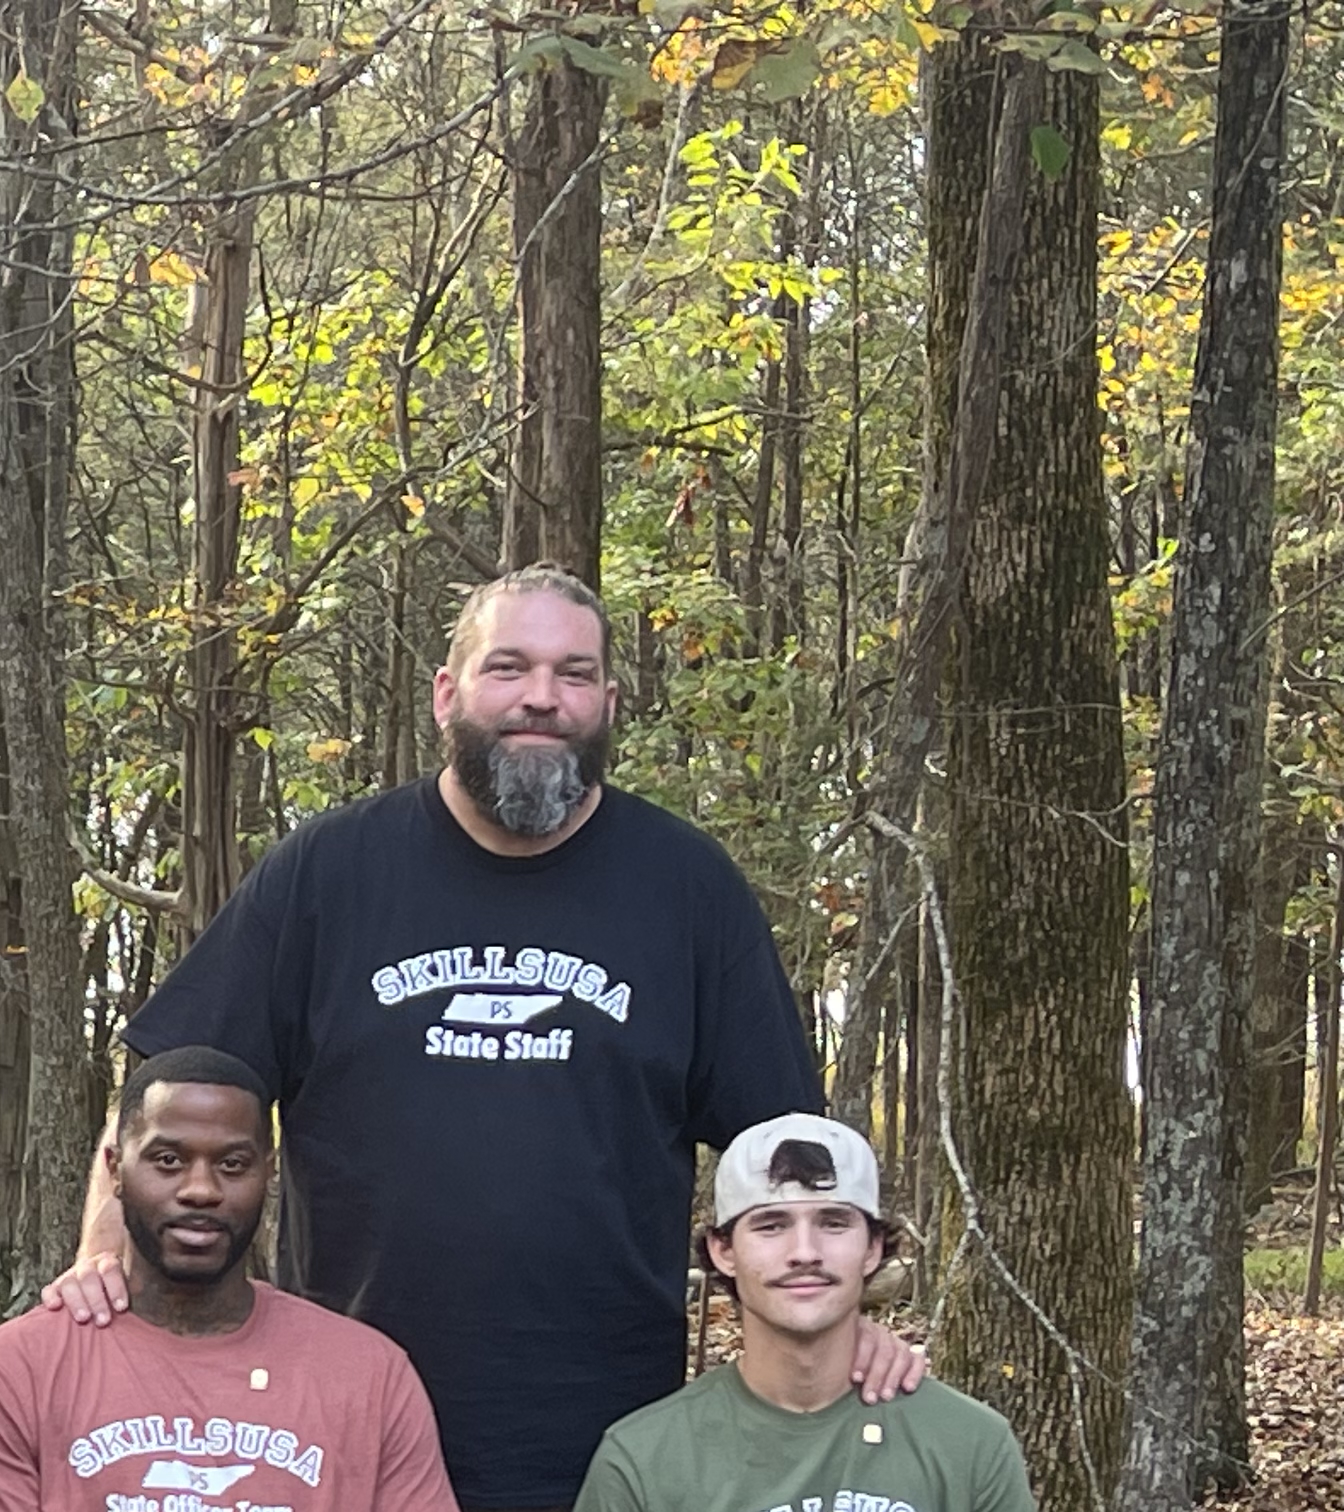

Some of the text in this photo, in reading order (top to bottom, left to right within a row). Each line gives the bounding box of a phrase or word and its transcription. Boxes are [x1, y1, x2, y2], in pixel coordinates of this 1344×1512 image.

[372, 947, 631, 1022] SKILLSUSA
[491, 1001, 512, 1018] PS
[426, 1026, 573, 1059] State Staff
[69, 1415, 324, 1487] SKILLSUSA
